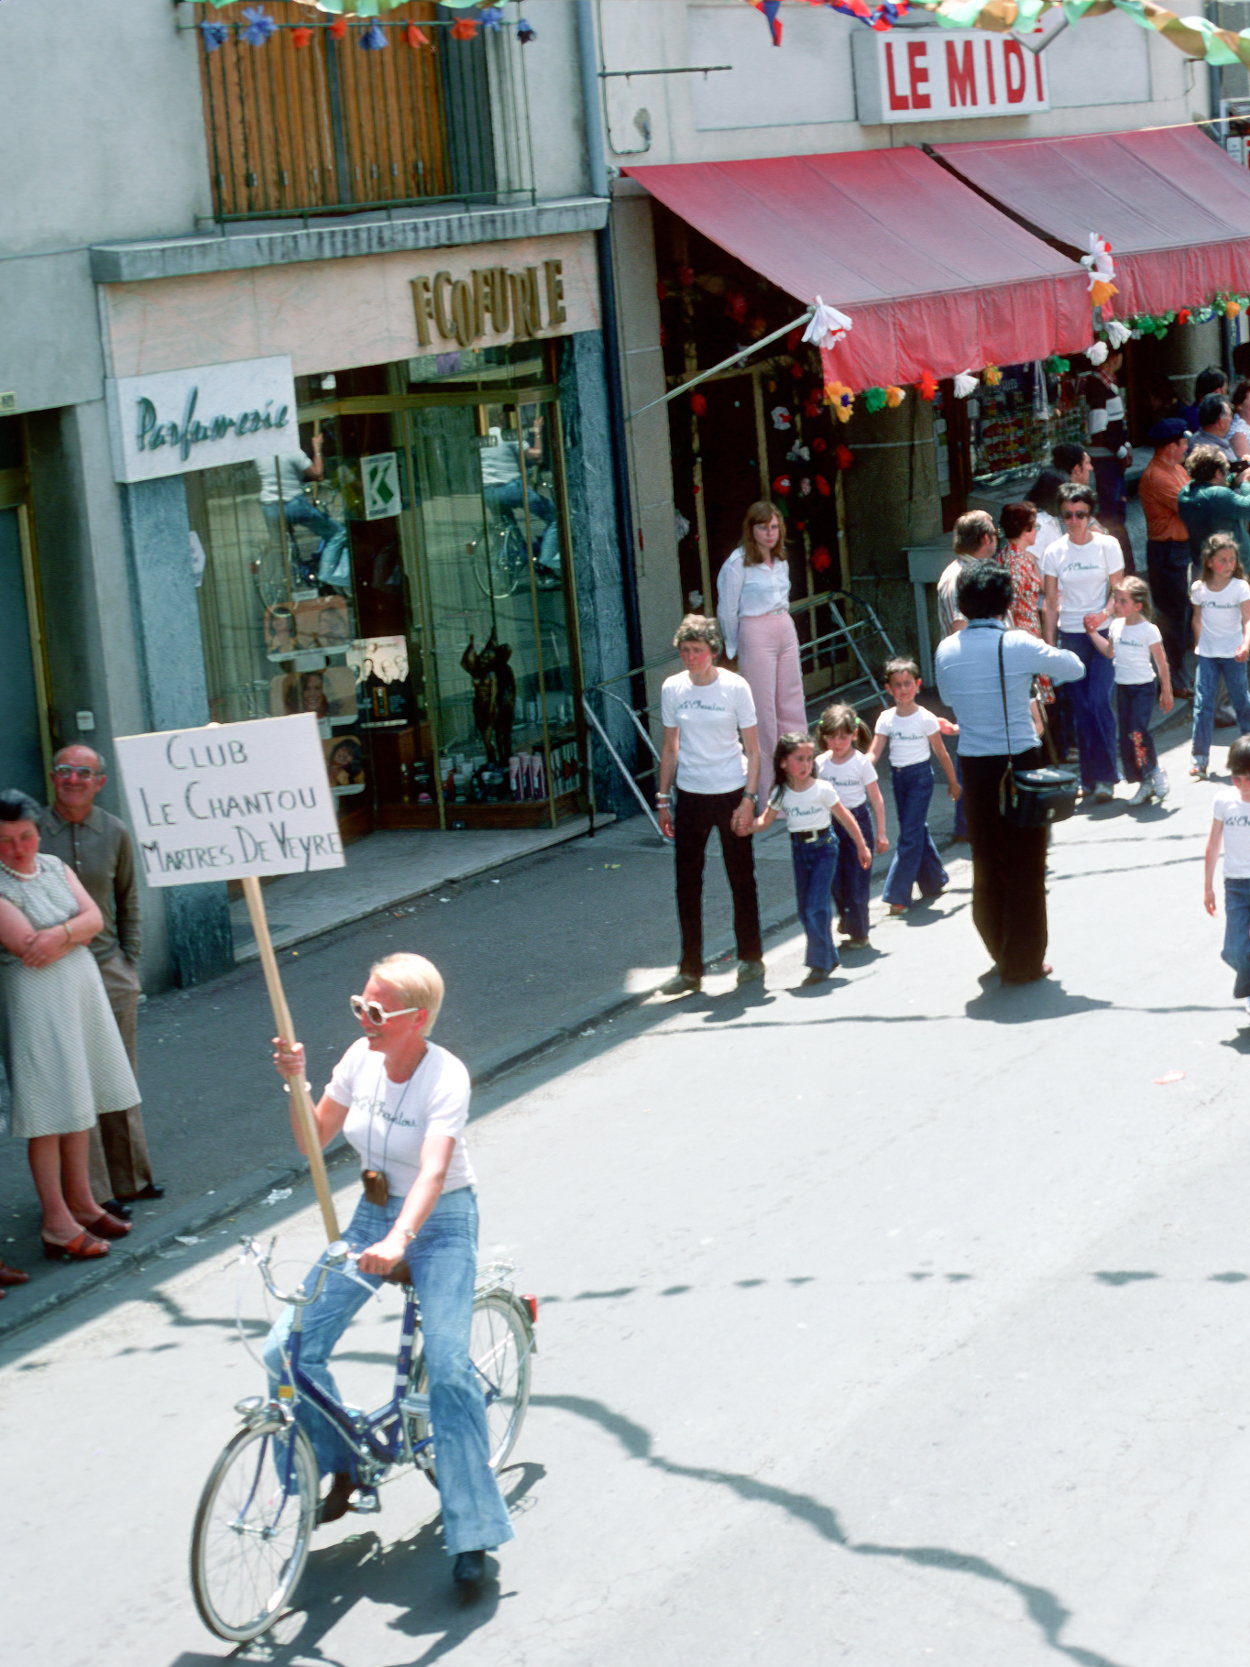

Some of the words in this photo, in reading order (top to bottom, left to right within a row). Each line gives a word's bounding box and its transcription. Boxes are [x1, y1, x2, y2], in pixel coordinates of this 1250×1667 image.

[885, 41, 932, 110] LE
[944, 39, 1045, 108] MIDI
[136, 384, 290, 462] Parfumerie
[166, 735, 248, 770] CLUB
[139, 787, 178, 828] LE
[184, 779, 317, 821] CHANTOU
[140, 840, 235, 874] MARTRES
[232, 825, 272, 864] DE
[269, 821, 344, 873] VEYRE
